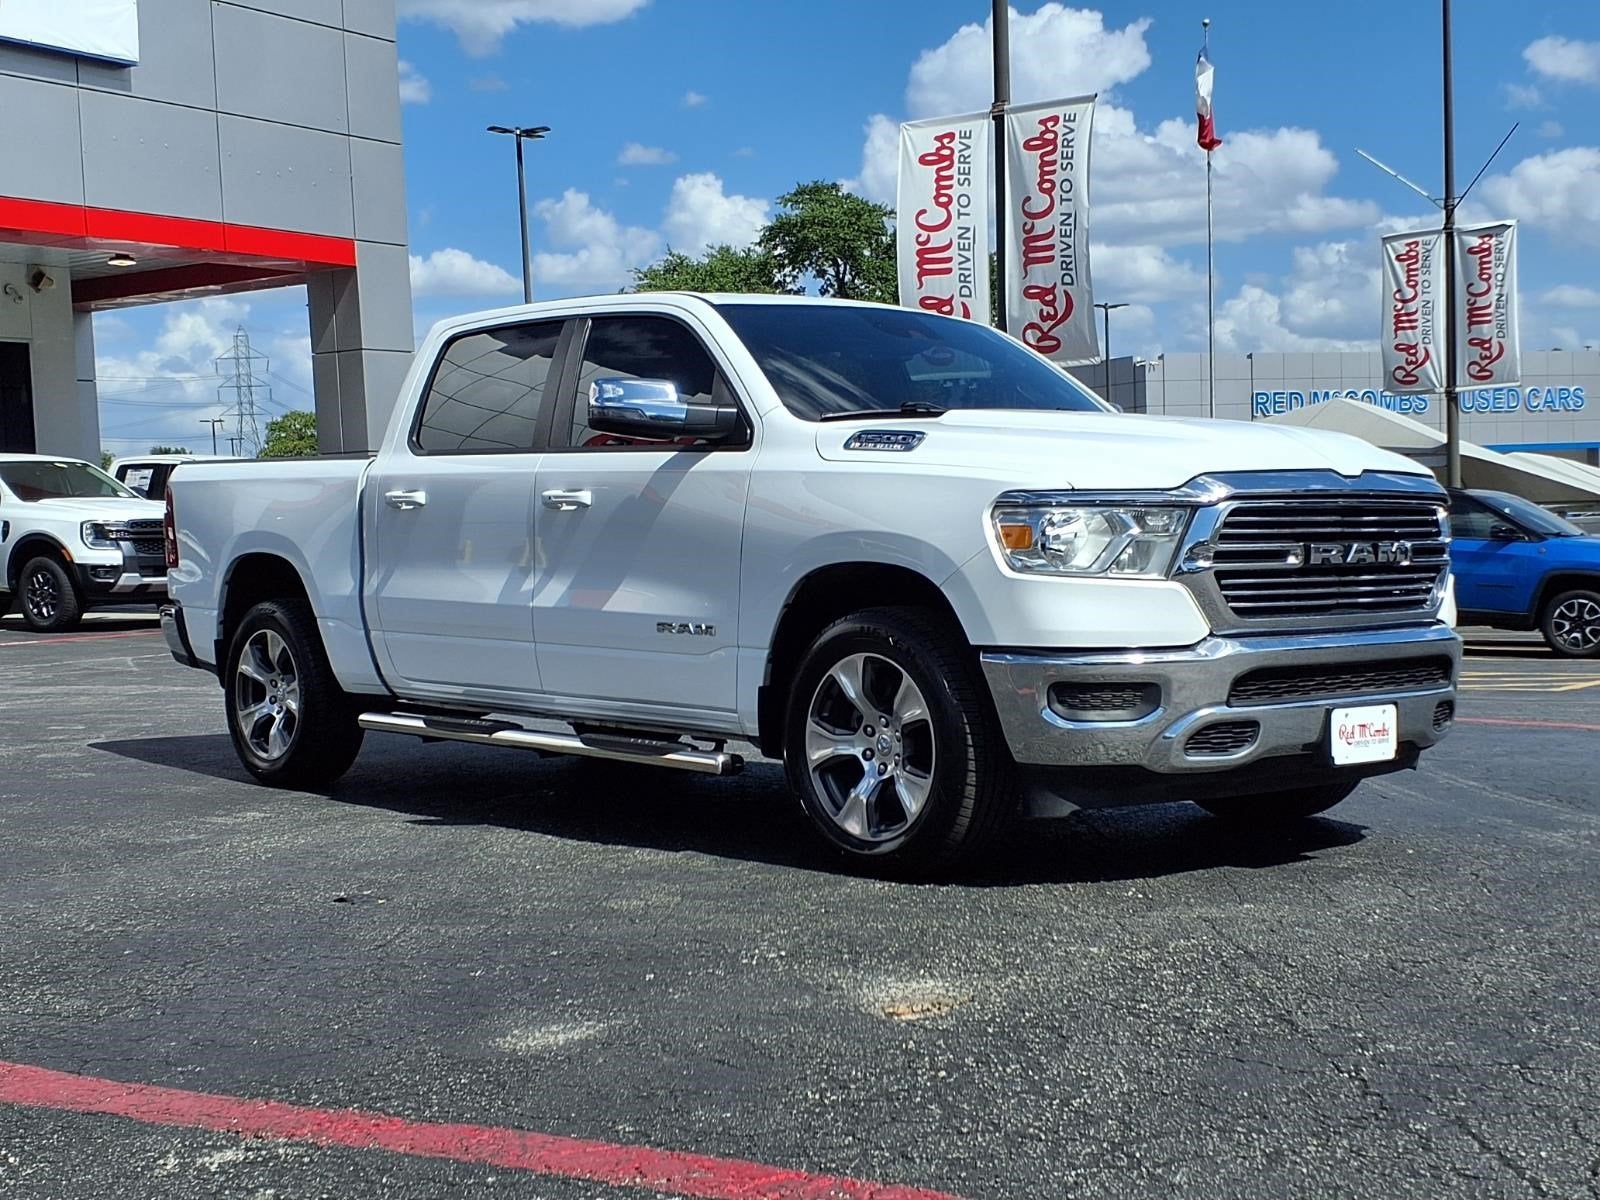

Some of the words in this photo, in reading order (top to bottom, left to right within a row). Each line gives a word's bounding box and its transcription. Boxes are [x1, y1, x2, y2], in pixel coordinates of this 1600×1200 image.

[957, 129, 972, 188] SERVE
[1061, 112, 1076, 173] SERVE
[914, 131, 956, 290] McCombs
[957, 194, 971, 218] TO
[1021, 114, 1061, 280] McCombs
[1060, 177, 1073, 206] TO
[958, 226, 972, 298] DRIVEN
[1061, 213, 1073, 287] DRIVEN
[1421, 239, 1432, 275] SERVE
[1495, 231, 1505, 271] SERVE
[1393, 240, 1420, 340] McCombs
[1421, 279, 1432, 296] TO
[1466, 233, 1494, 334] McCombs
[1494, 275, 1505, 291] TO
[1021, 282, 1074, 354] Red
[1422, 300, 1432, 345] DRIVEN
[1495, 293, 1506, 339] DRIVEN
[1392, 342, 1430, 386] Red
[1466, 336, 1505, 381] Red
[1254, 390, 1304, 415] RED
[1461, 387, 1520, 411] USED
[1526, 386, 1585, 411] CARS
[858, 433, 914, 444] 1500
[1309, 542, 1411, 565] RAM
[656, 621, 717, 637] RAM
[1339, 723, 1355, 746] Red
